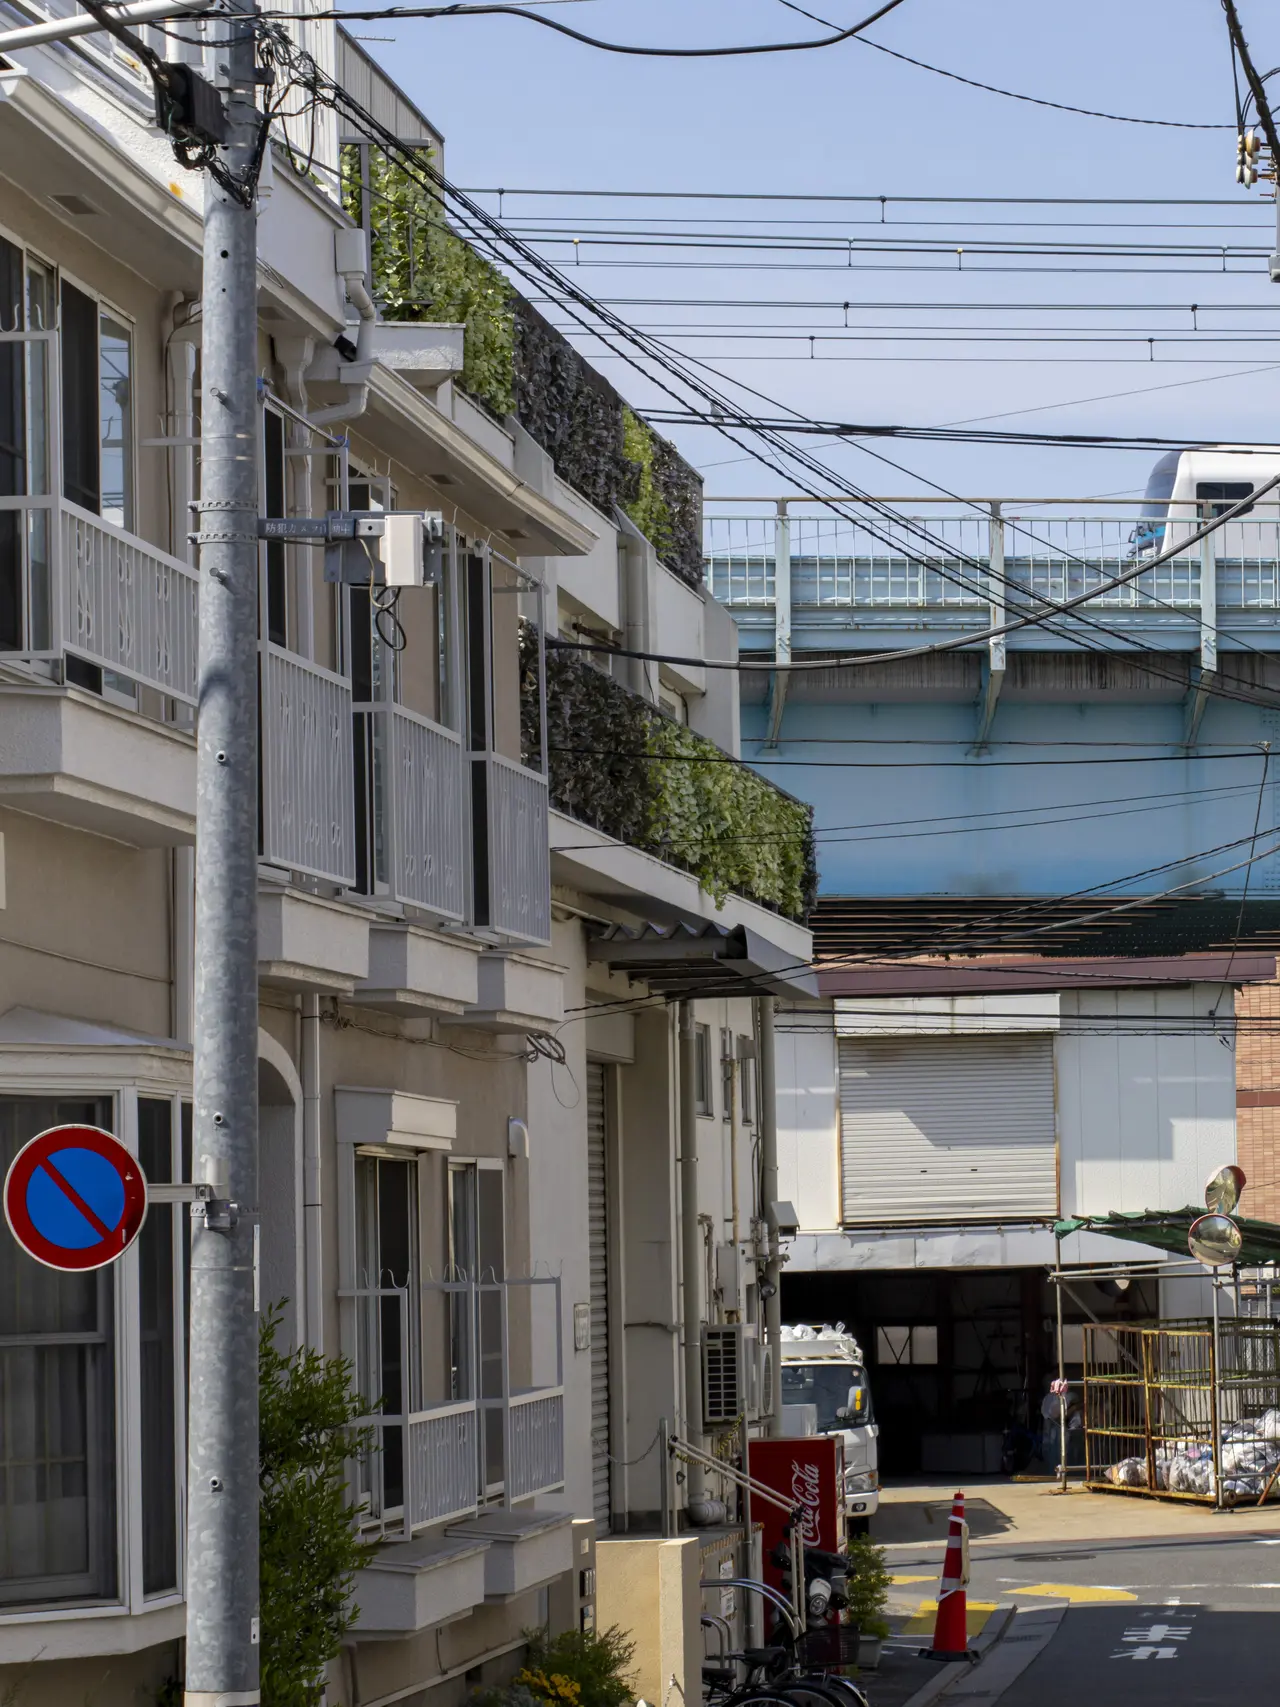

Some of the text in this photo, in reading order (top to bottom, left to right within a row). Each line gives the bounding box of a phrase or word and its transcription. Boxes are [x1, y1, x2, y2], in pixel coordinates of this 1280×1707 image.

[265, 522, 350, 535] 防犯カメラ動中
[1109, 1596, 1200, 1660] 止まれ
